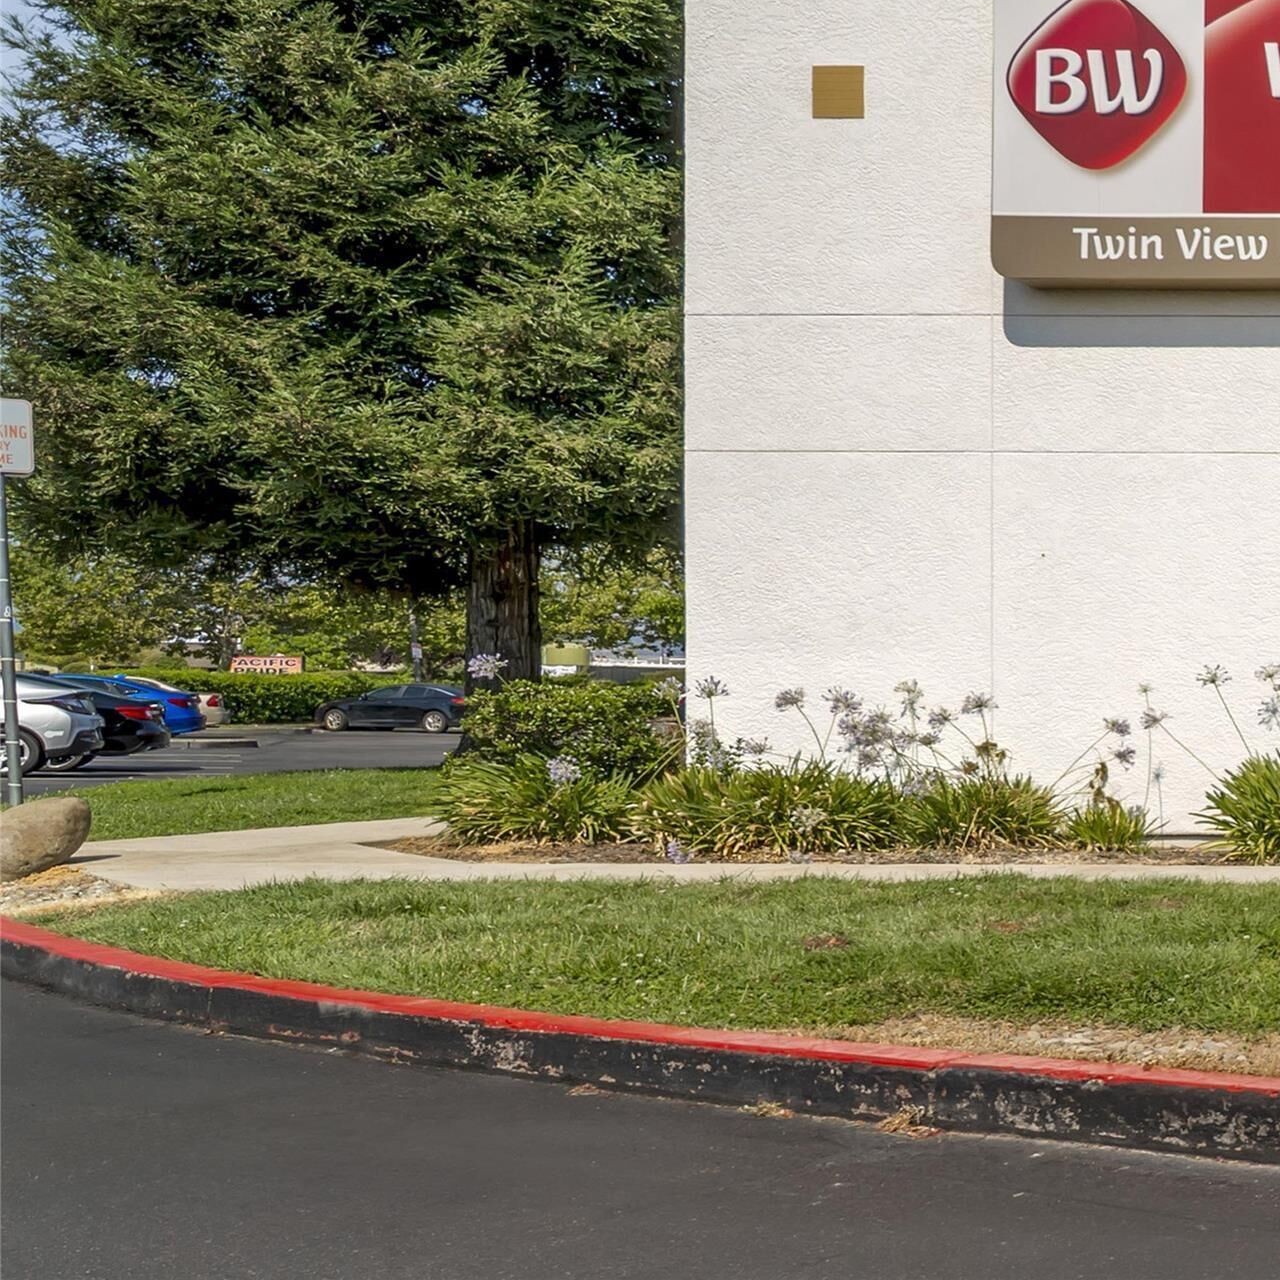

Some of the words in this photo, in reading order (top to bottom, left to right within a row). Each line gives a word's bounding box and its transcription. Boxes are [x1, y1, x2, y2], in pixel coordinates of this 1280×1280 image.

[1034, 47, 1164, 115] BW
[1072, 226, 1164, 261] Twin
[1175, 226, 1268, 261] View
